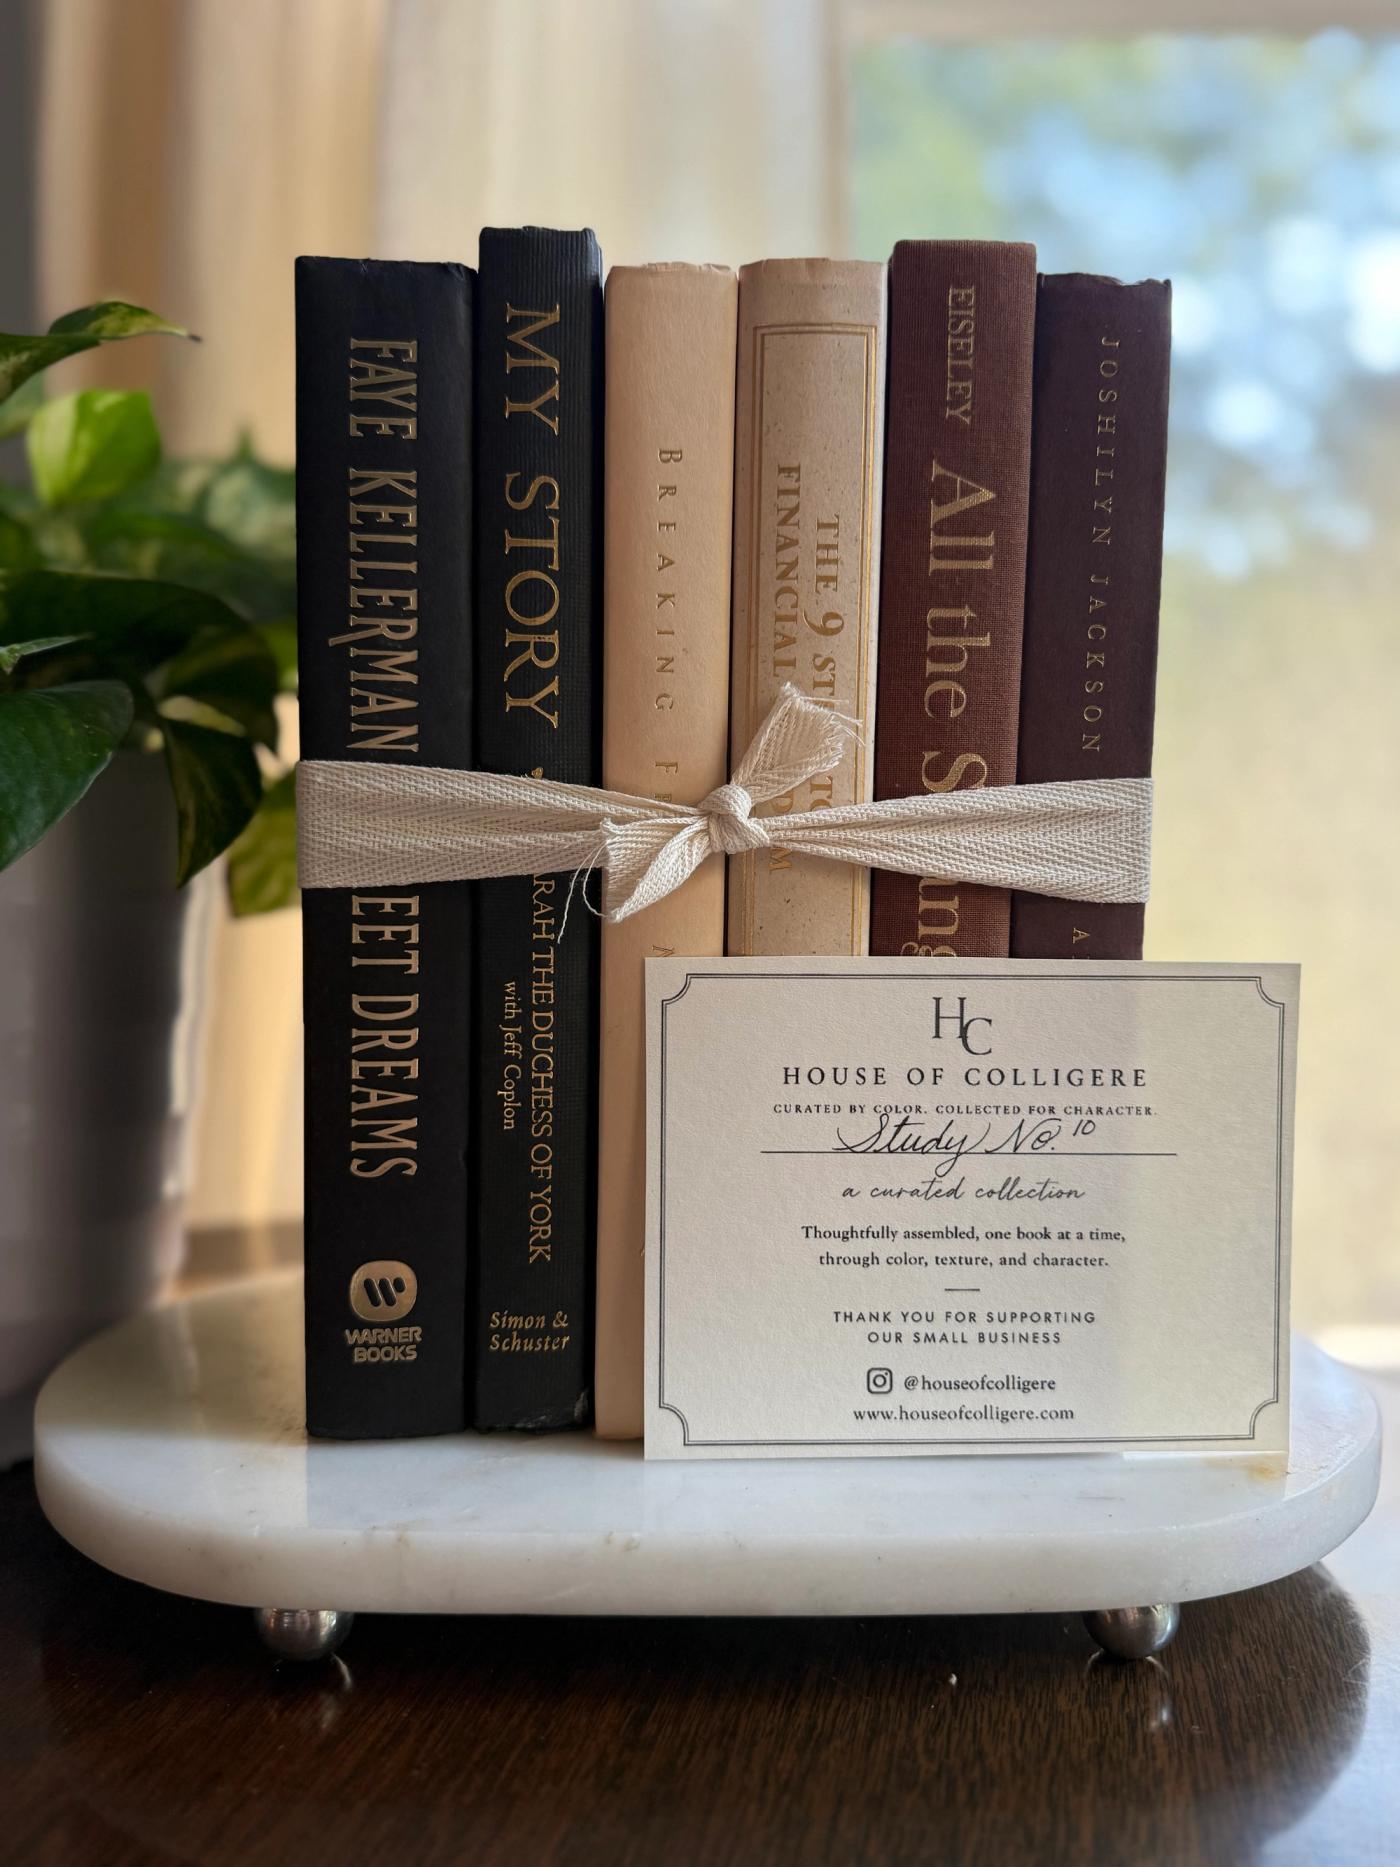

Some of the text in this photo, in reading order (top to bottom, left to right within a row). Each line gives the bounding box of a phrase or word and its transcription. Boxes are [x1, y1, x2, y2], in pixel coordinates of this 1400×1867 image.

[946, 285, 975, 425] EISELEY
[504, 303, 560, 728] MY STORY
[929, 458, 996, 577] All
[329, 338, 419, 752] FAYE KELLERMAN
[815, 514, 840, 595] THE
[1082, 337, 1120, 752] JOSHILYN JACKSON
[655, 448, 683, 710] BREAKING
[774, 464, 800, 677] FINANCIAL
[804, 610, 844, 636] 9
[924, 603, 992, 718] the
[350, 895, 419, 1177] EET DREAMS
[497, 982, 522, 1130] with Jeff Coplon
[529, 874, 555, 1263] RAH THE DUCHESS OF YORK
[783, 1067, 1145, 1087] HOUSE OF COLLIGERE
[772, 1103, 1158, 1117] CURATED BY COLOR. COLLECTED FOR CHARACTER.
[833, 1113, 1096, 1177] Study No. 10
[841, 1175, 1085, 1201] a curated collection
[801, 1225, 1125, 1242] Thoughtfully assembled, one book at a time,
[820, 1251, 1108, 1268] through color, texture, and character.
[490, 1310, 568, 1329] Simon &
[833, 1310, 1096, 1324] THANK YOU FOR SUPPORTING
[345, 1326, 423, 1345] WARNER
[490, 1331, 569, 1351] Schuster
[867, 1331, 1061, 1345] OUR SMALL BUSINESS
[353, 1344, 418, 1364] BOOKS
[904, 1374, 1056, 1393] @houseofcolligere
[853, 1404, 1074, 1424] www.houseofcolligere.com
